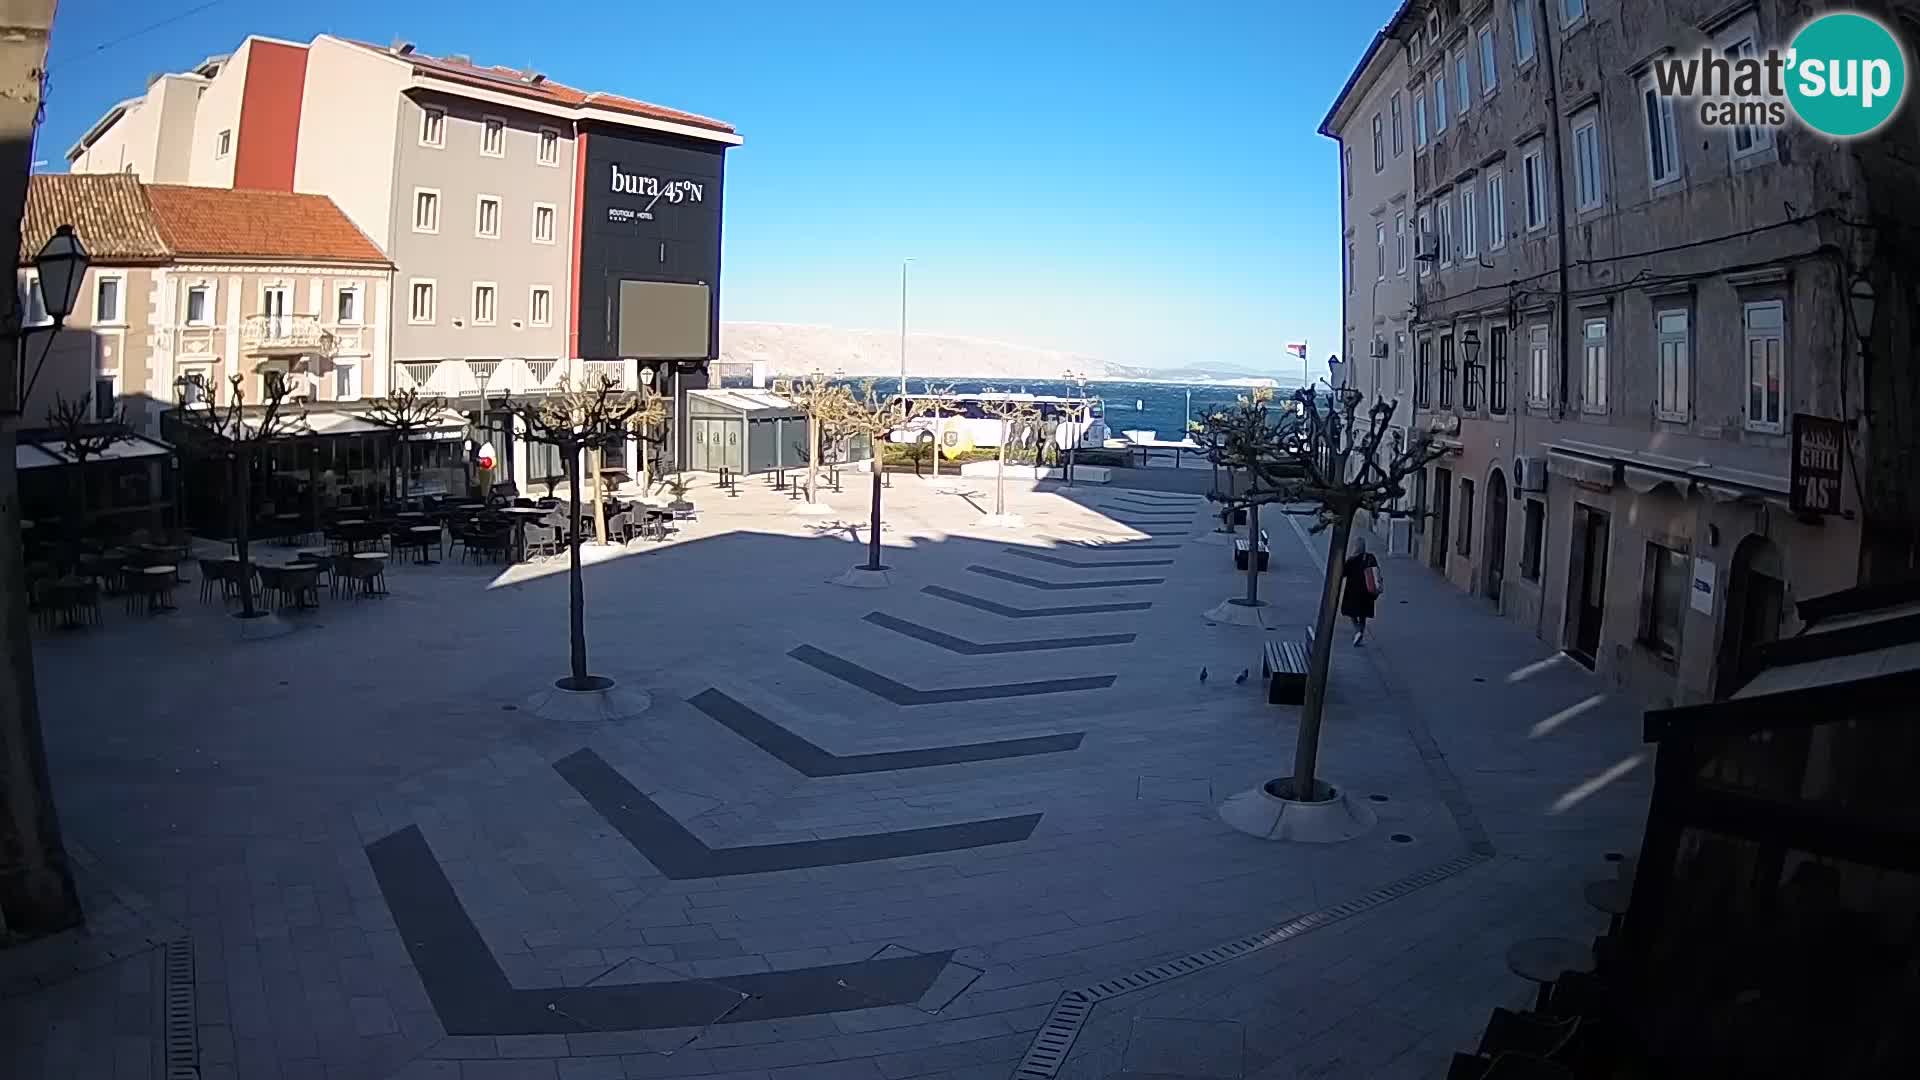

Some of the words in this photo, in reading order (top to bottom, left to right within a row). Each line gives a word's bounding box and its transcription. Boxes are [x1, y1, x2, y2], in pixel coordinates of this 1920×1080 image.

[611, 165, 658, 196] bura
[608, 208, 634, 218] BOUTIQUE
[637, 212, 653, 220] HOTEL
[1800, 448, 1839, 471] GRILL
